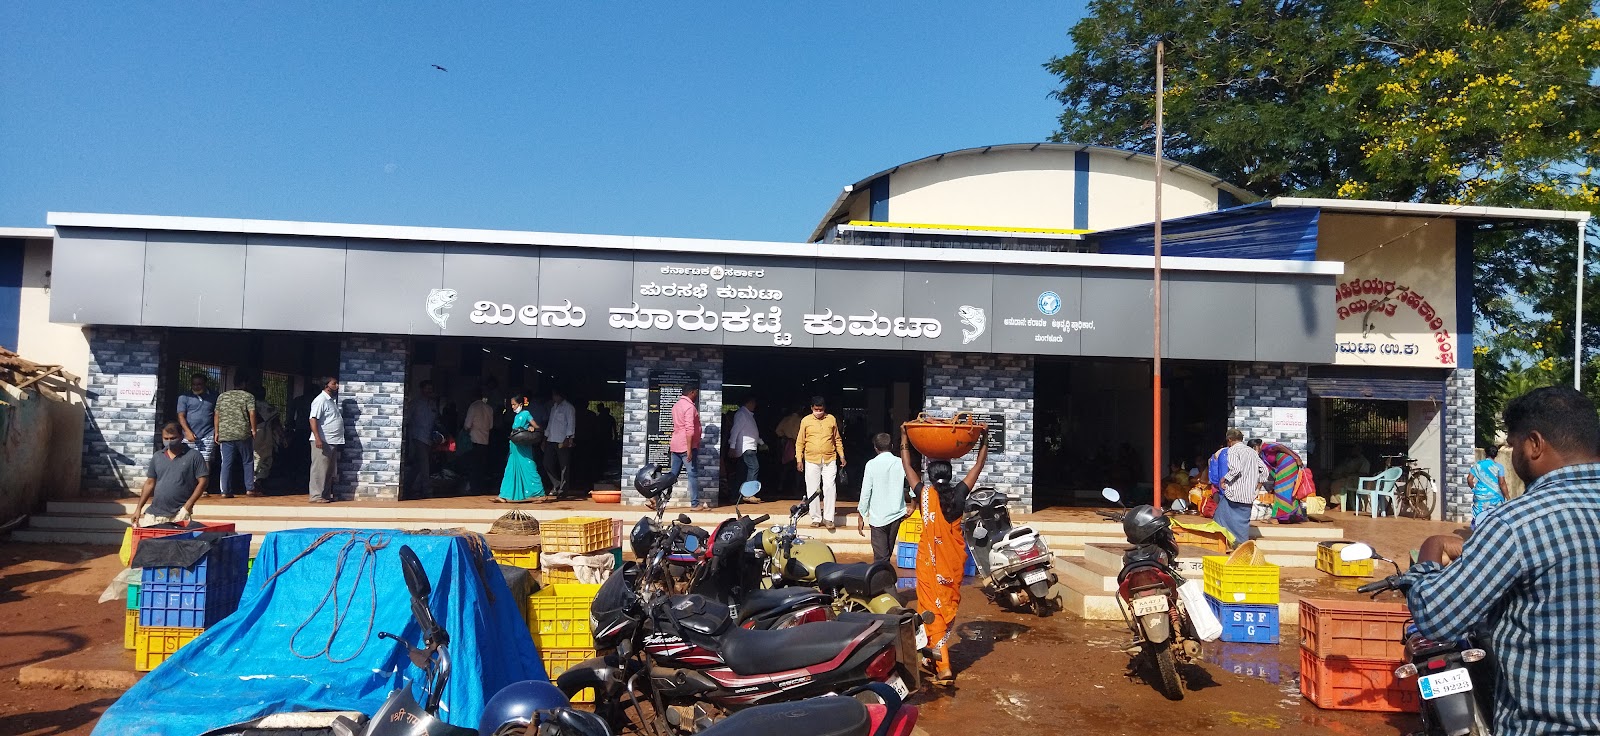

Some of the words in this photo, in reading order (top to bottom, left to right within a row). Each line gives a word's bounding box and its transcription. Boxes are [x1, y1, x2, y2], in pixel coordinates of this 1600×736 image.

[660, 265, 710, 276] ಕರ್ನಾಟಕ
[724, 267, 765, 279] ಸರ್ಕಾರ
[640, 281, 708, 299] ಪುರಸಭೆ
[716, 284, 783, 301] ಕುಮಟಾ
[469, 298, 587, 328] ಮೀನು
[608, 300, 793, 346] ಮಾರುಕಟ್ಟೆ
[803, 307, 942, 339] ಕುಮಟಾ
[1034, 333, 1063, 343] ಮಂಗಳೂರು
[1138, 604, 1166, 614] 7817
[1433, 687, 1441, 695] S
[1443, 680, 1470, 693] 9223
[1434, 677, 1449, 685] KA
